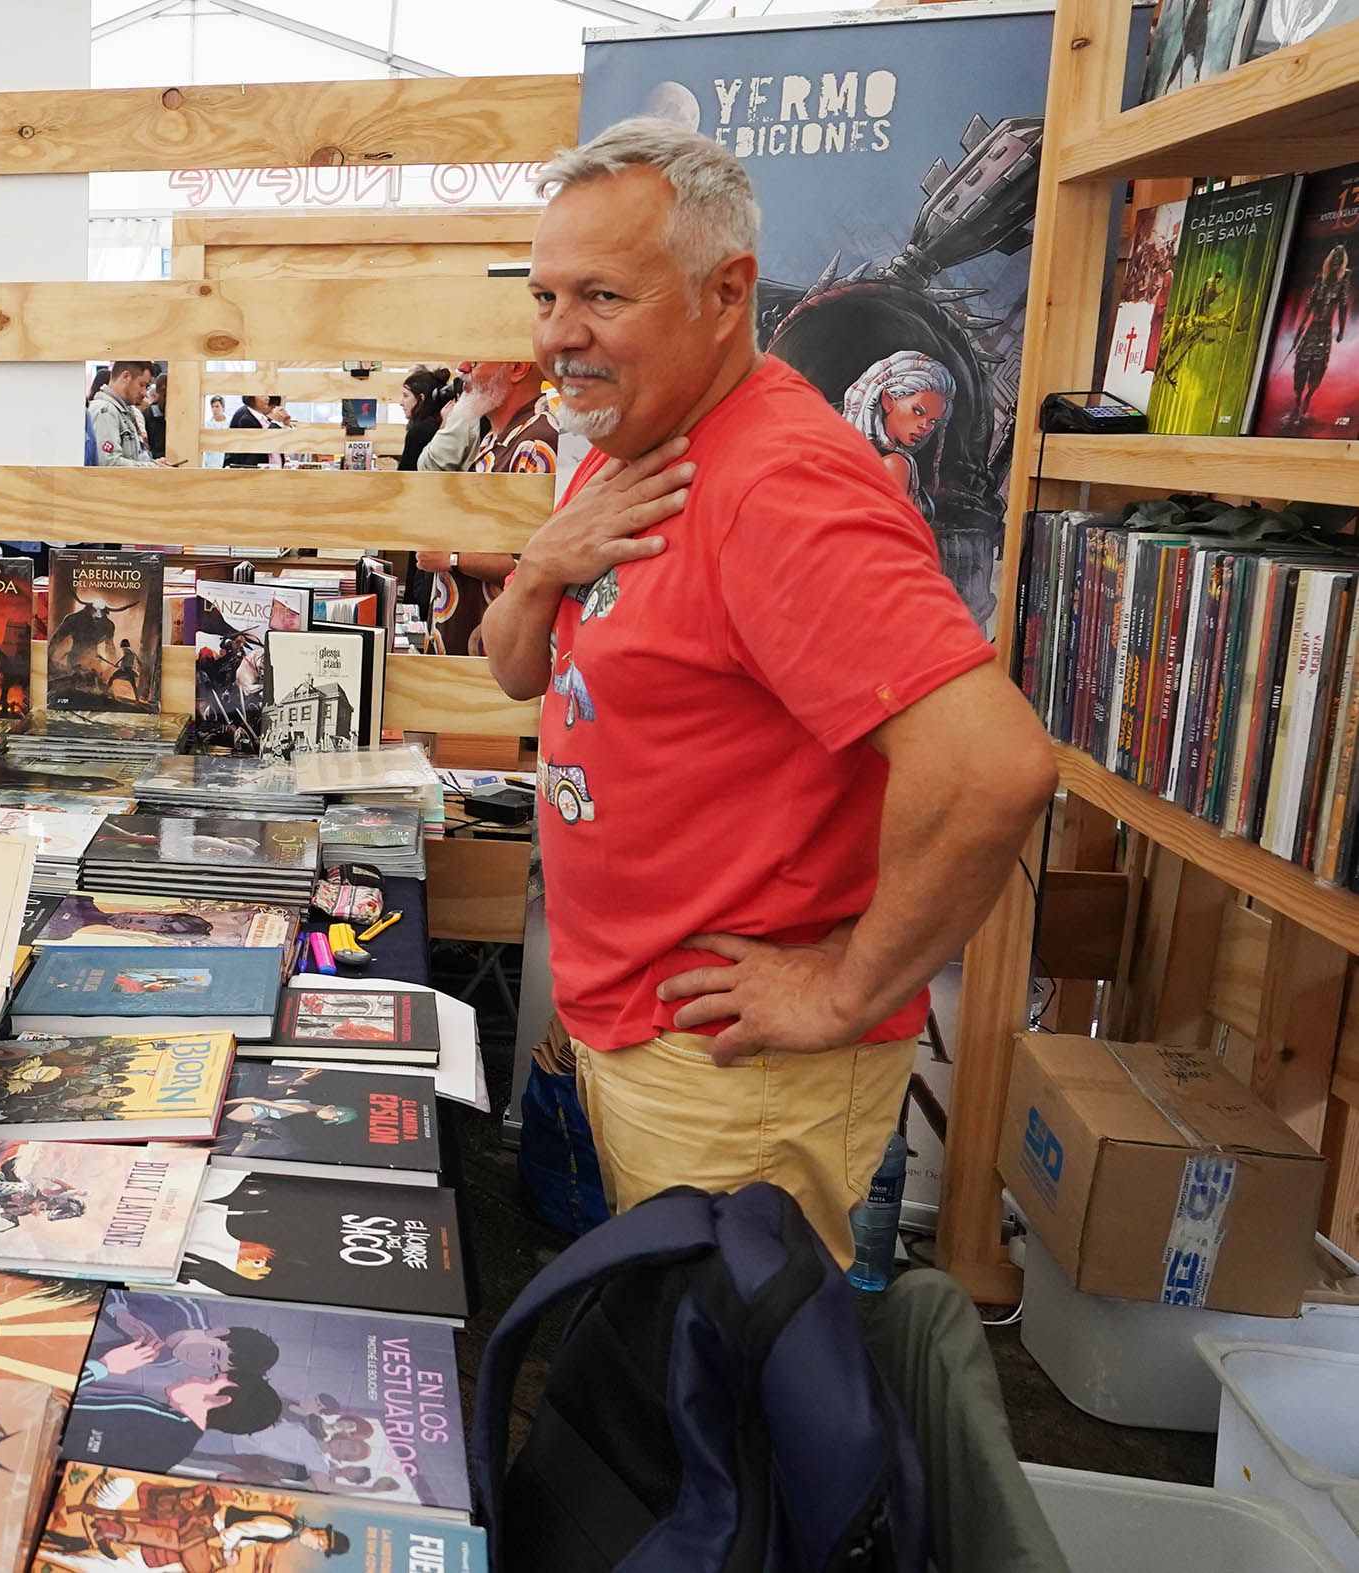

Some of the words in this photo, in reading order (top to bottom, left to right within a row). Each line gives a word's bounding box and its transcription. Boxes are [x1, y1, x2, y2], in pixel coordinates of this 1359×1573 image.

[713, 70, 897, 125] YERMO
[715, 119, 891, 158] EDICIONES
[1190, 202, 1274, 231] CAZADORES
[1197, 229, 1215, 245] DE
[1217, 222, 1259, 242] SAVIA
[72, 568, 142, 581] LABERINTO
[72, 580, 87, 588] DEL
[88, 581, 141, 590] MINOTAURO
[1168, 635, 1177, 657] NIEVE
[1118, 655, 1127, 685] SIMÓN
[1129, 655, 1141, 708] DANNY
[1164, 674, 1172, 695] COMO
[1162, 697, 1170, 719] ROJO
[156, 1040, 212, 1104] BJORN
[402, 1099, 418, 1108] EL
[402, 1108, 419, 1133] CAMINO
[124, 1161, 170, 1194] BILLY
[102, 1196, 158, 1249] LAVIGNE
[404, 1219, 425, 1231] EL
[339, 1214, 398, 1268] SACO
[385, 1234, 402, 1251] DEL
[401, 1231, 429, 1270] HOMBRE
[416, 1371, 445, 1398] EN
[381, 1337, 418, 1478] VESTUARIOS
[418, 1401, 449, 1443] LOS
